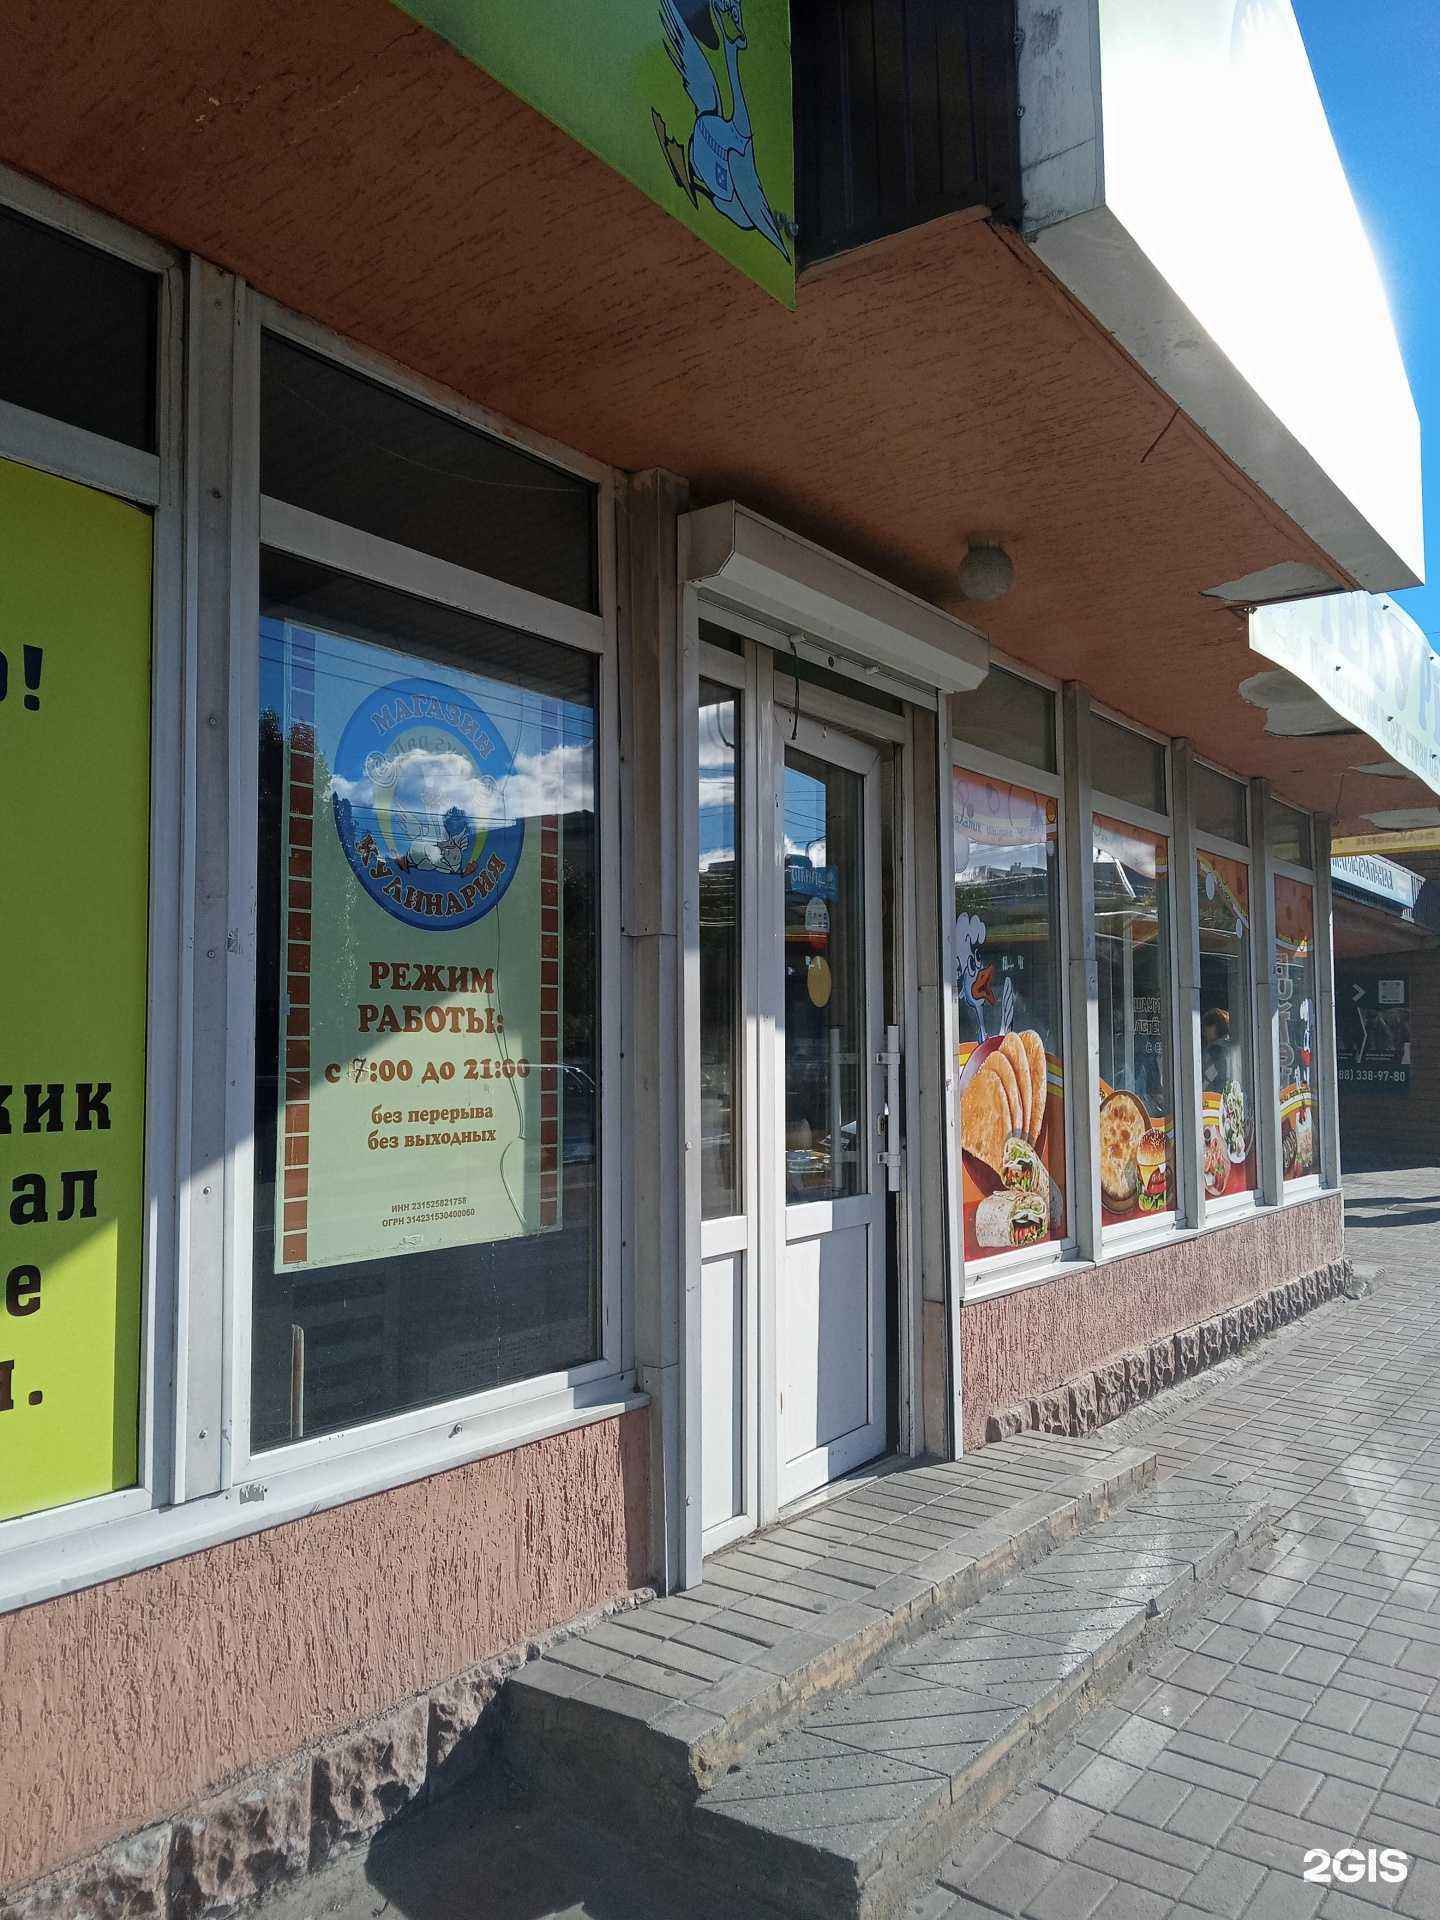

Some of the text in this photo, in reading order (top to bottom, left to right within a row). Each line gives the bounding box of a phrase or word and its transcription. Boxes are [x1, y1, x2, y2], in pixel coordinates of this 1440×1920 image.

[370, 694, 495, 760] МАГАЗИН
[356, 833, 507, 917] КУЛИНАРИЯ
[368, 961, 495, 994] РЕЖИМ
[357, 1004, 504, 1033] РАБОТЫ:
[352, 1057, 413, 1083] 7:00
[421, 1061, 455, 1084] до
[463, 1058, 530, 1080] 21:00
[371, 1104, 494, 1125] без перерыва
[368, 1129, 496, 1150] без выходных
[391, 1203, 409, 1213] ИНН
[382, 1217, 404, 1227] ОГРН
